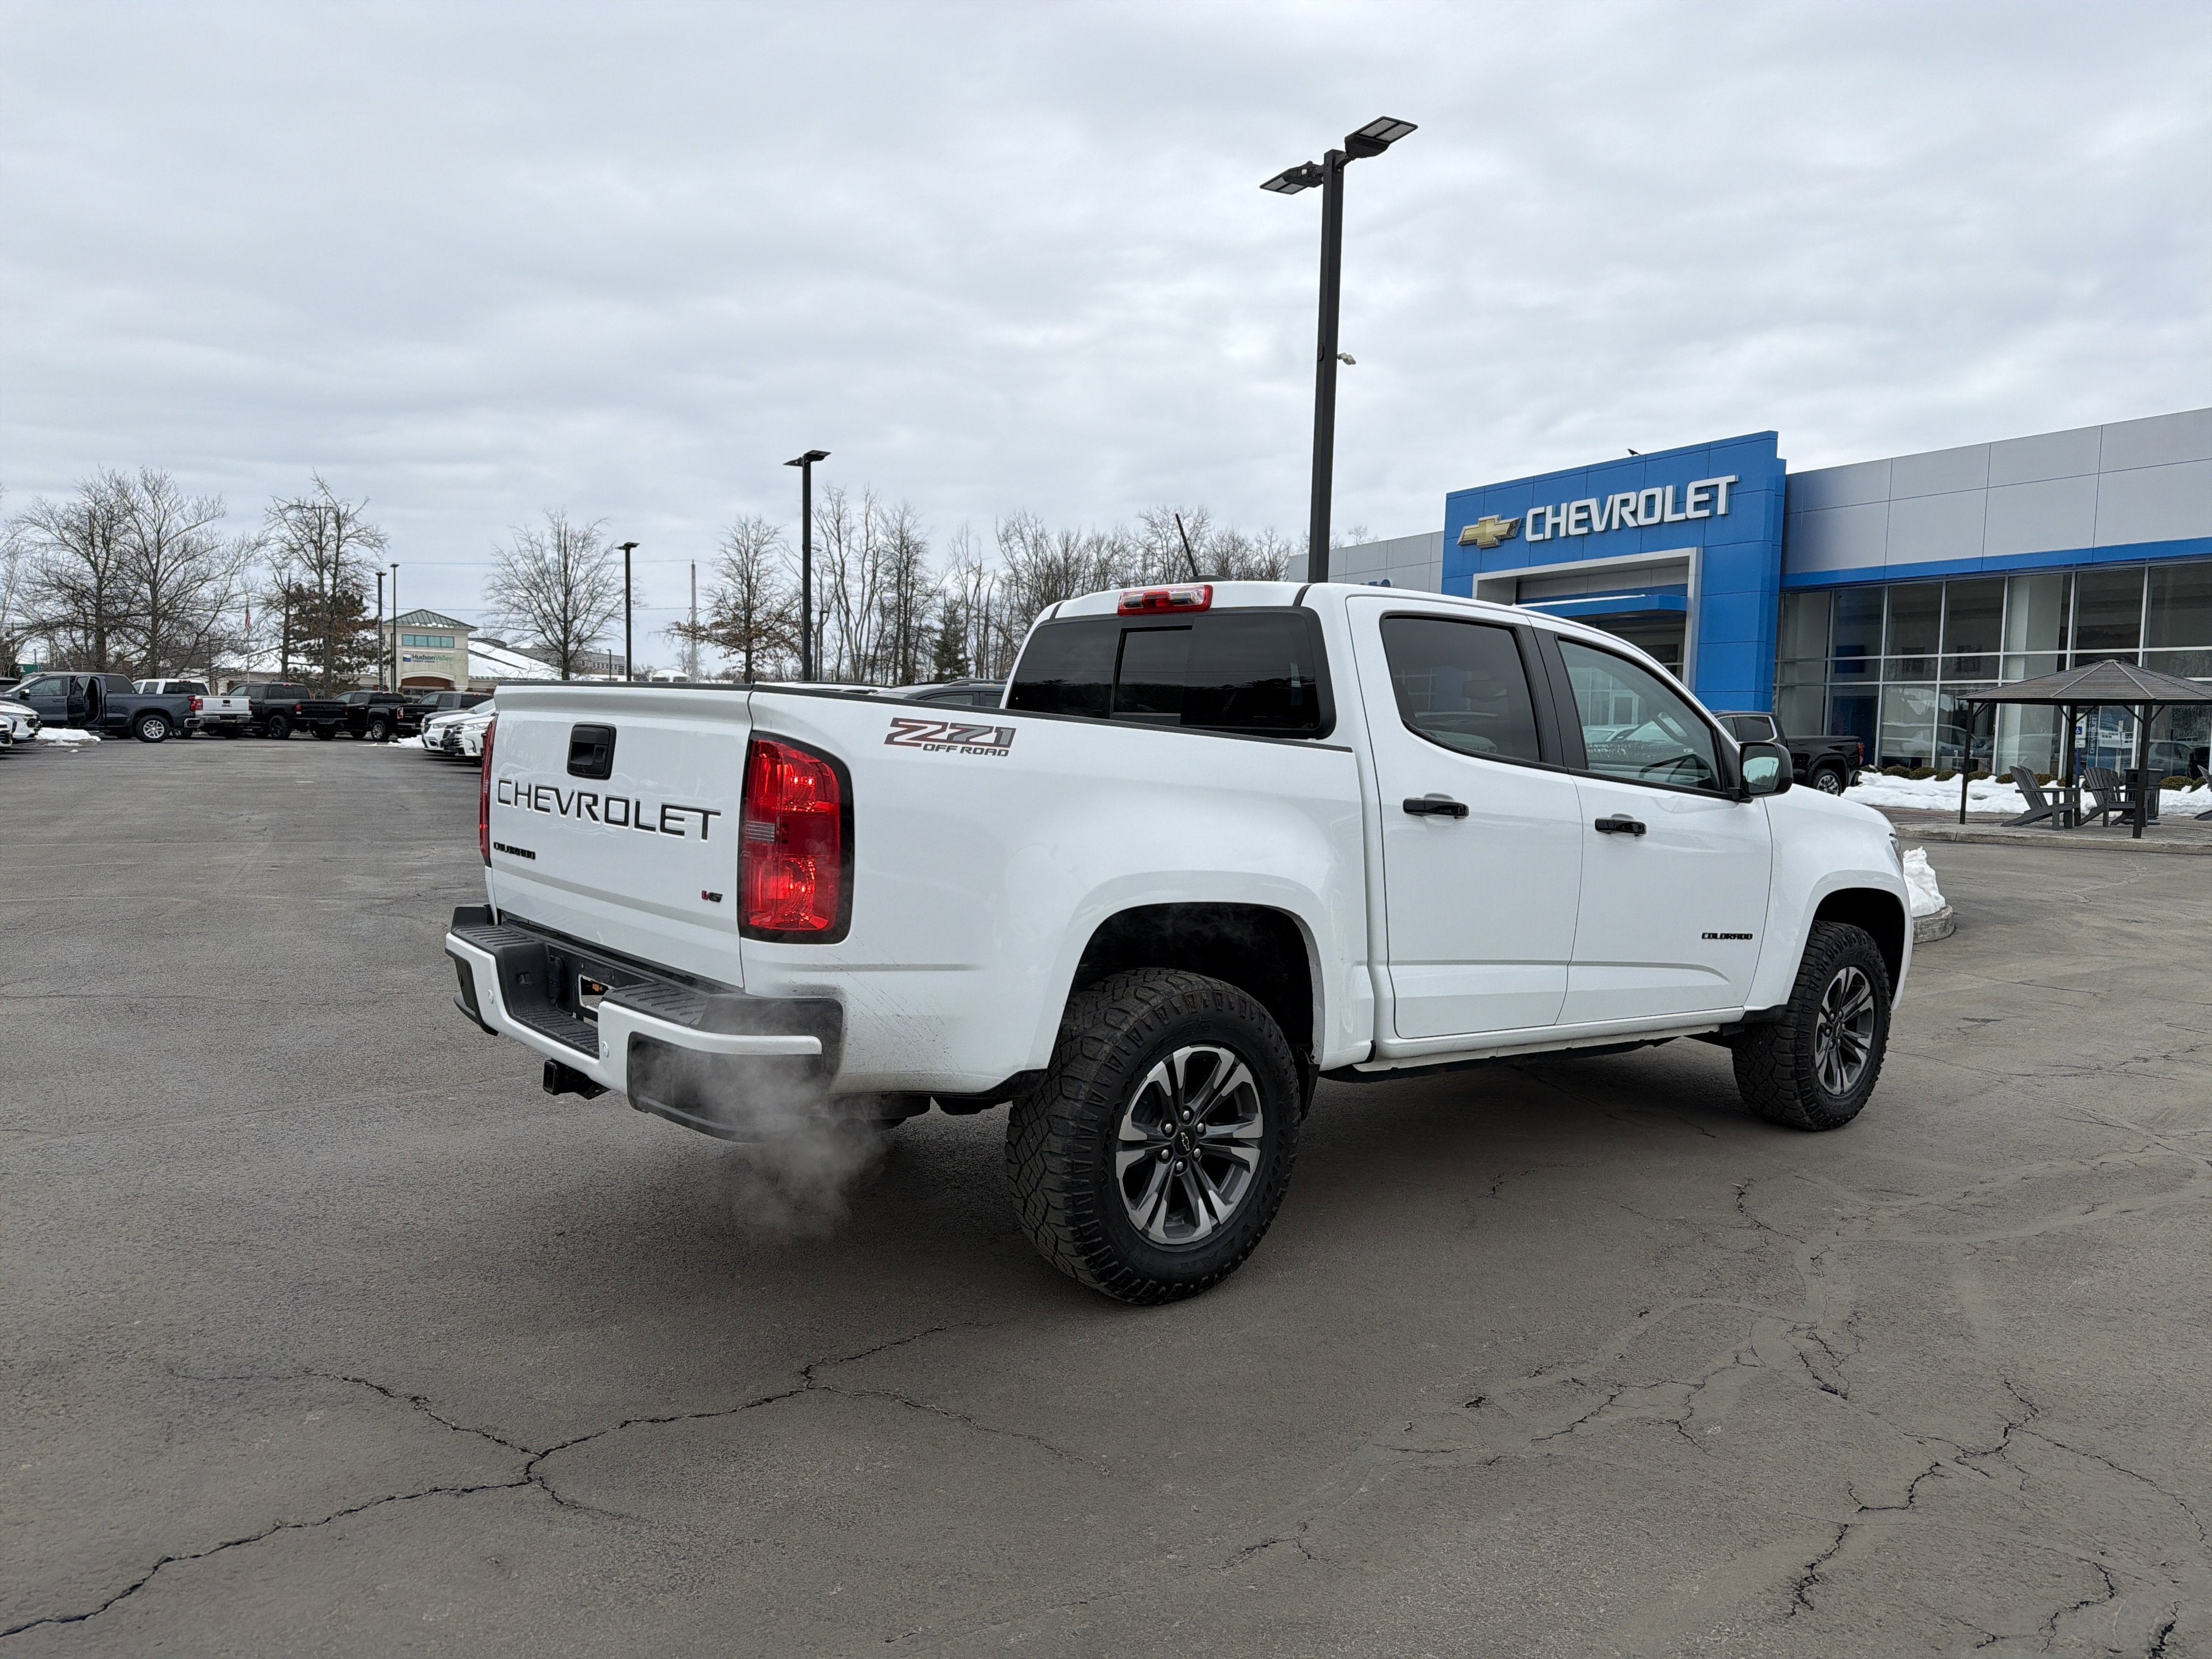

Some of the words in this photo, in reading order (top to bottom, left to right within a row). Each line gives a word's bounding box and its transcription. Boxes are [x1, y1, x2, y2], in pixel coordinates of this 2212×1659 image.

[1525, 475, 1738, 541] CHEVROLET
[884, 717, 1017, 748] Z71
[2089, 716, 2097, 754] CHEVROLET
[923, 743, 958, 753] OFF
[960, 746, 1009, 757] ROAD
[497, 778, 721, 841] CHEVROLET
[702, 890, 723, 903] V6
